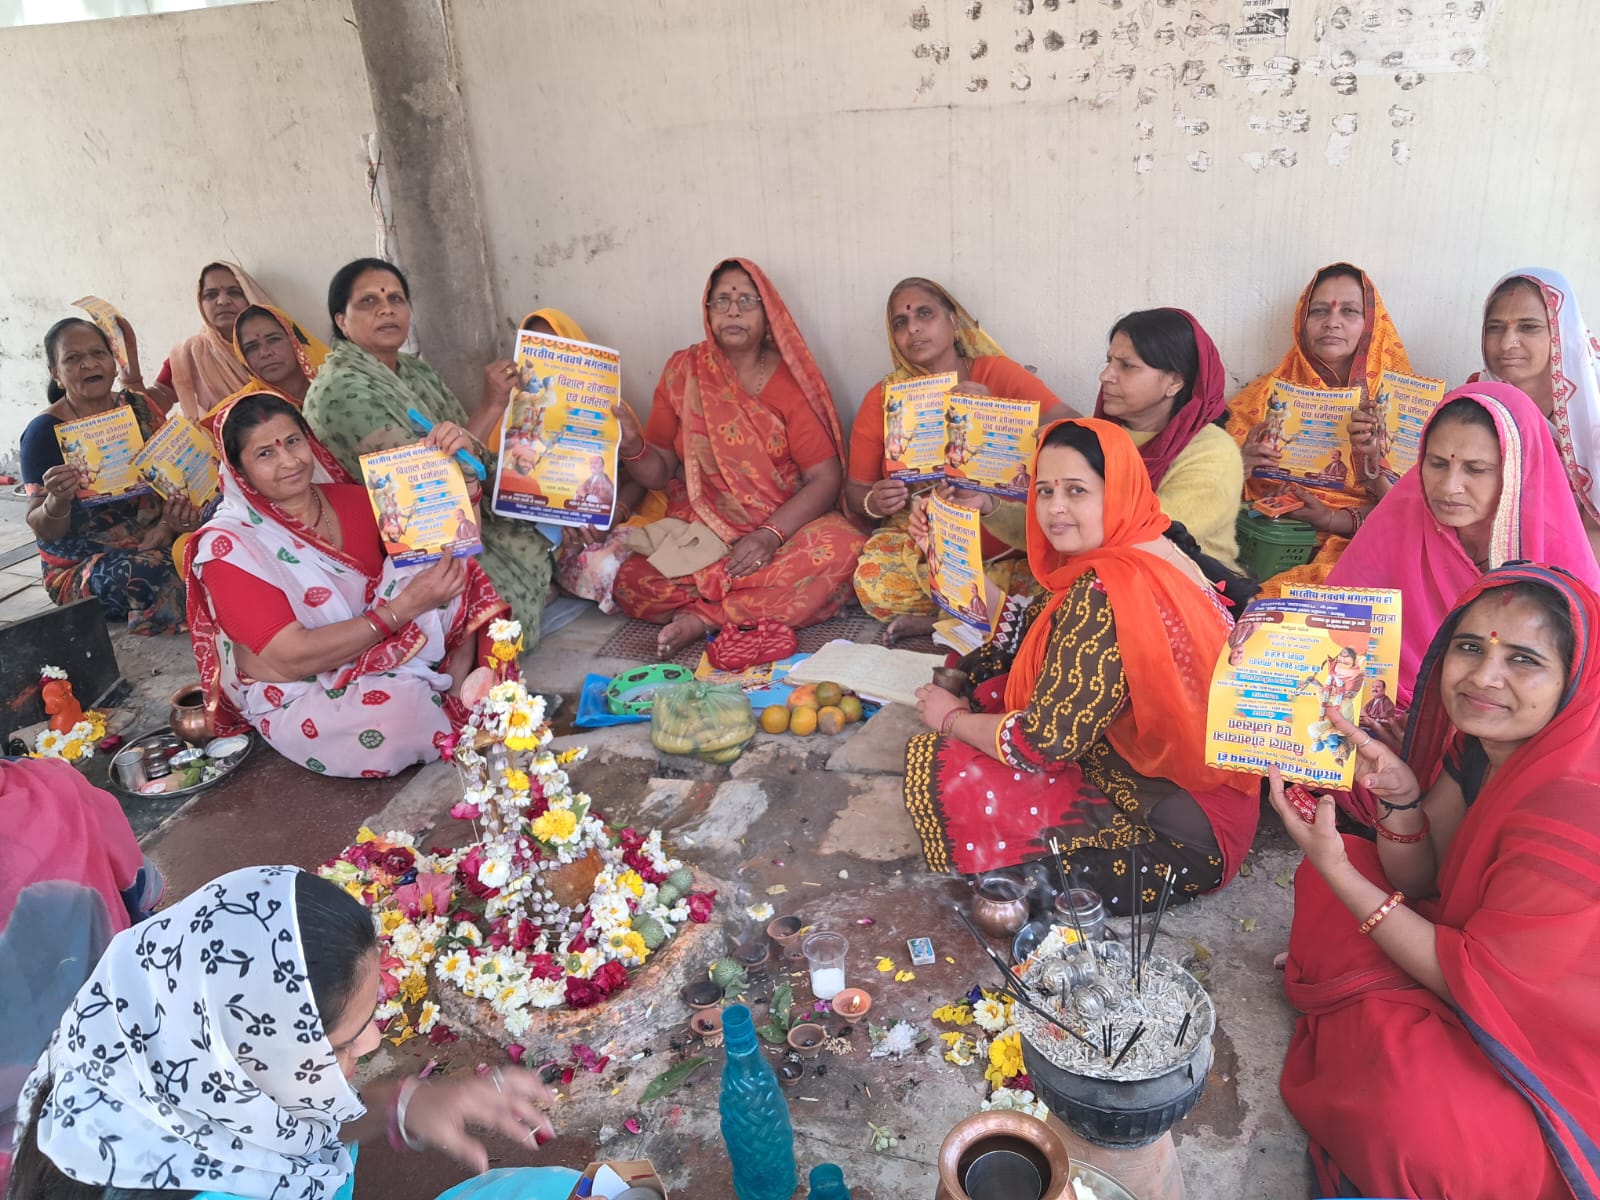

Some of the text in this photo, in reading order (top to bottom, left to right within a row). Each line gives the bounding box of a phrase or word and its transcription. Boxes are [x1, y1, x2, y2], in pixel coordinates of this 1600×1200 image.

[523, 346, 554, 360] भारतीय
[1289, 588, 1318, 599] भारतीय
[1228, 719, 1272, 734] धर्मसभा
[1213, 731, 1304, 757] विशाल शोभायात्रा
[1305, 767, 1342, 780] भारतीय
